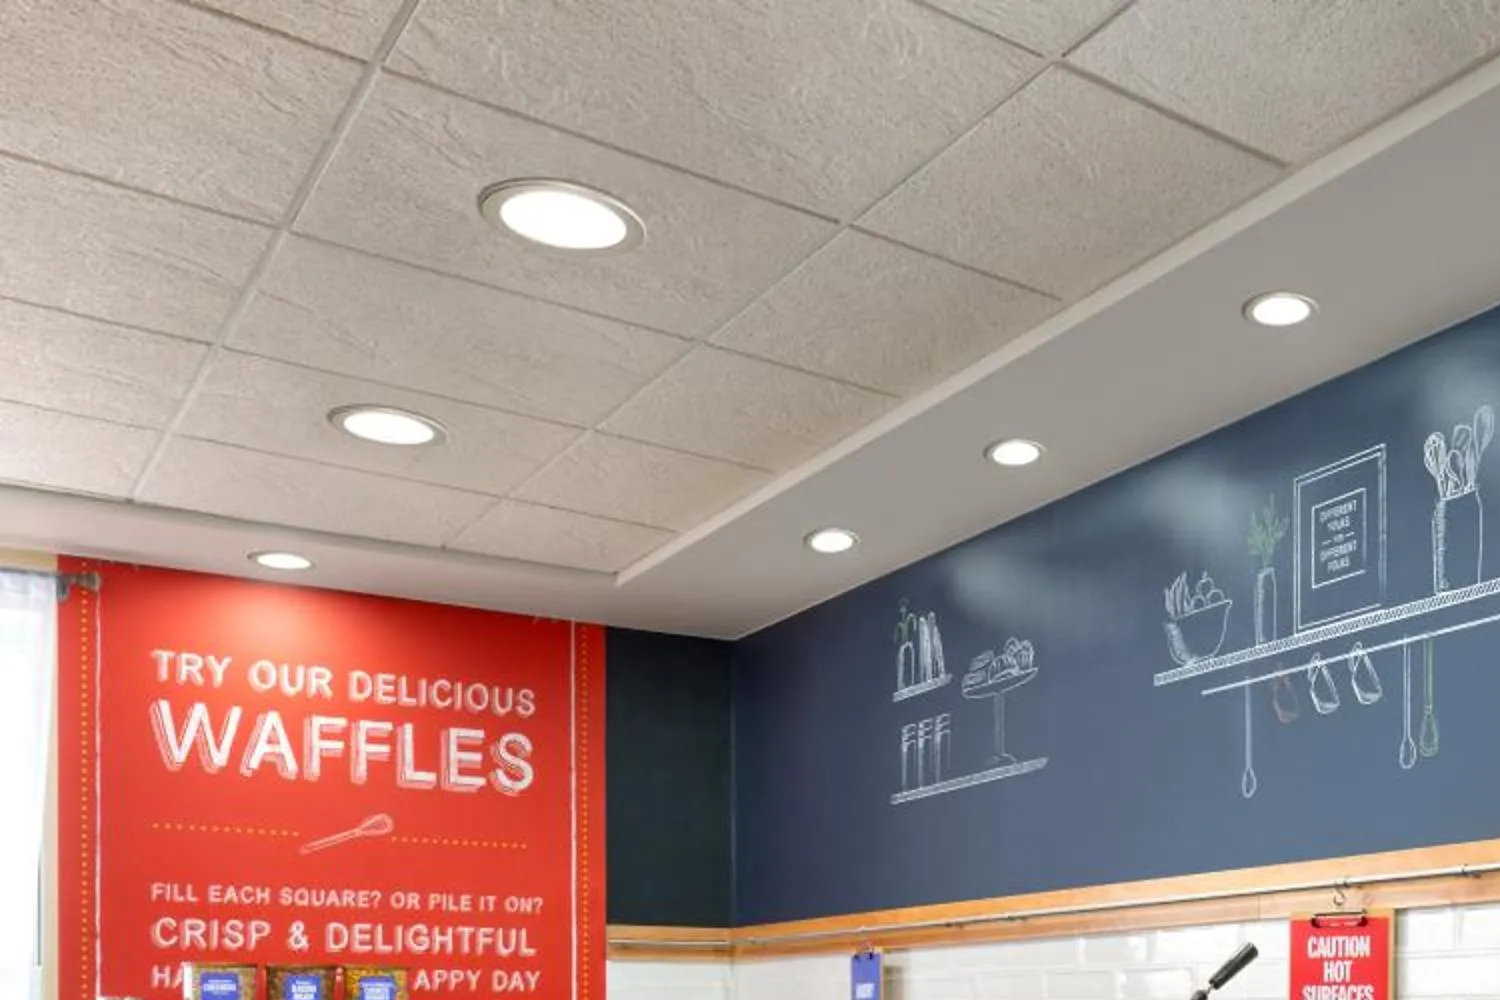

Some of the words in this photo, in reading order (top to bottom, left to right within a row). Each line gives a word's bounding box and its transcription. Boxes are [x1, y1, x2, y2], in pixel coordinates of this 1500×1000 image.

[151, 649, 232, 688] TRY
[248, 659, 333, 698] OUR
[349, 670, 536, 717] DELICIOUS
[150, 698, 534, 796] WAFFLES
[151, 882, 200, 902] FILL
[208, 885, 271, 905] EACH
[279, 888, 382, 908] SQUARE?
[390, 891, 421, 910] OR
[428, 893, 472, 912] PILE
[479, 895, 497, 912] IT
[504, 896, 544, 914] ON?
[151, 917, 271, 950] CRISP
[288, 921, 309, 951] &
[325, 922, 537, 957] DELIGHTFUL
[1306, 935, 1371, 958] CAUTION
[413, 969, 482, 992] APPY
[492, 970, 541, 993] DAY
[1323, 960, 1352, 982] HOT
